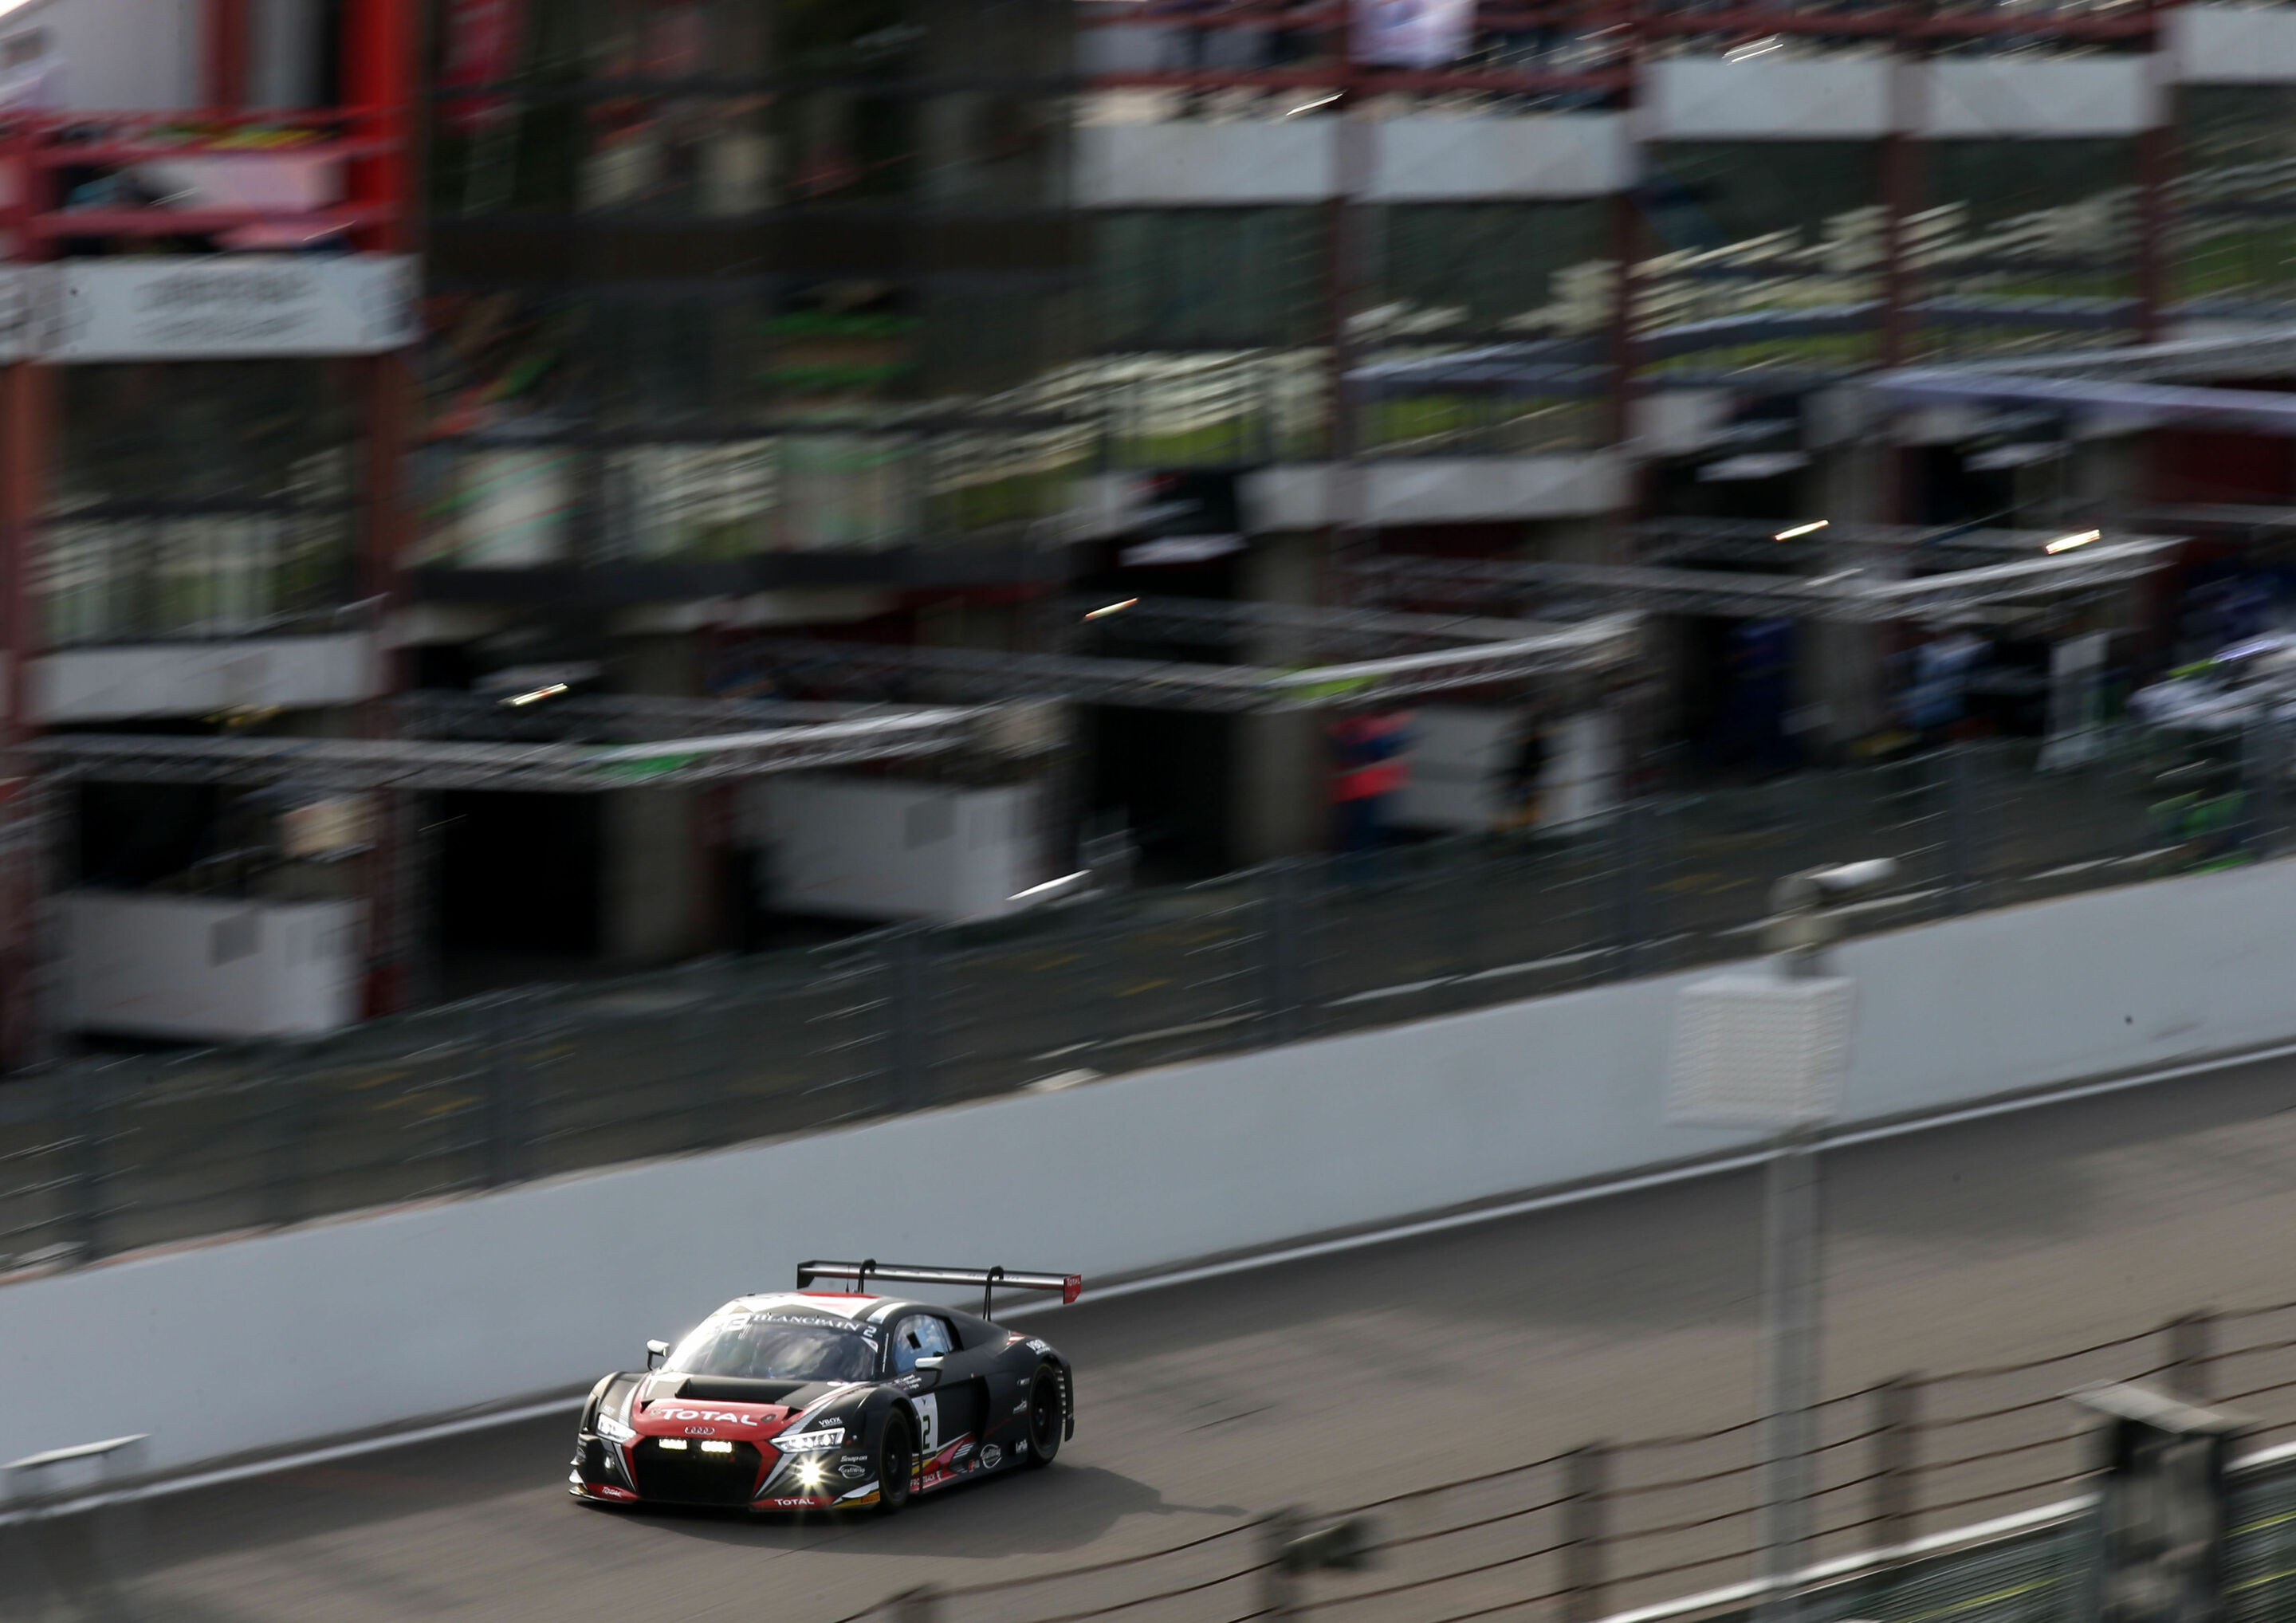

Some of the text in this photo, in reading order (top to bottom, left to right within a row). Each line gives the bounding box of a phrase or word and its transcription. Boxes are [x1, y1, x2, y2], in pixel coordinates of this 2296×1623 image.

[752, 1313, 860, 1332] BLANCPAIN
[863, 1326, 877, 1338] 2
[661, 1408, 758, 1427] TOTAL
[818, 1417, 843, 1426] VBOX
[923, 1414, 931, 1450] 2
[910, 1473, 935, 1487] FROTBACK
[601, 1486, 622, 1499] TOTAL
[774, 1498, 816, 1507] TOTAL
